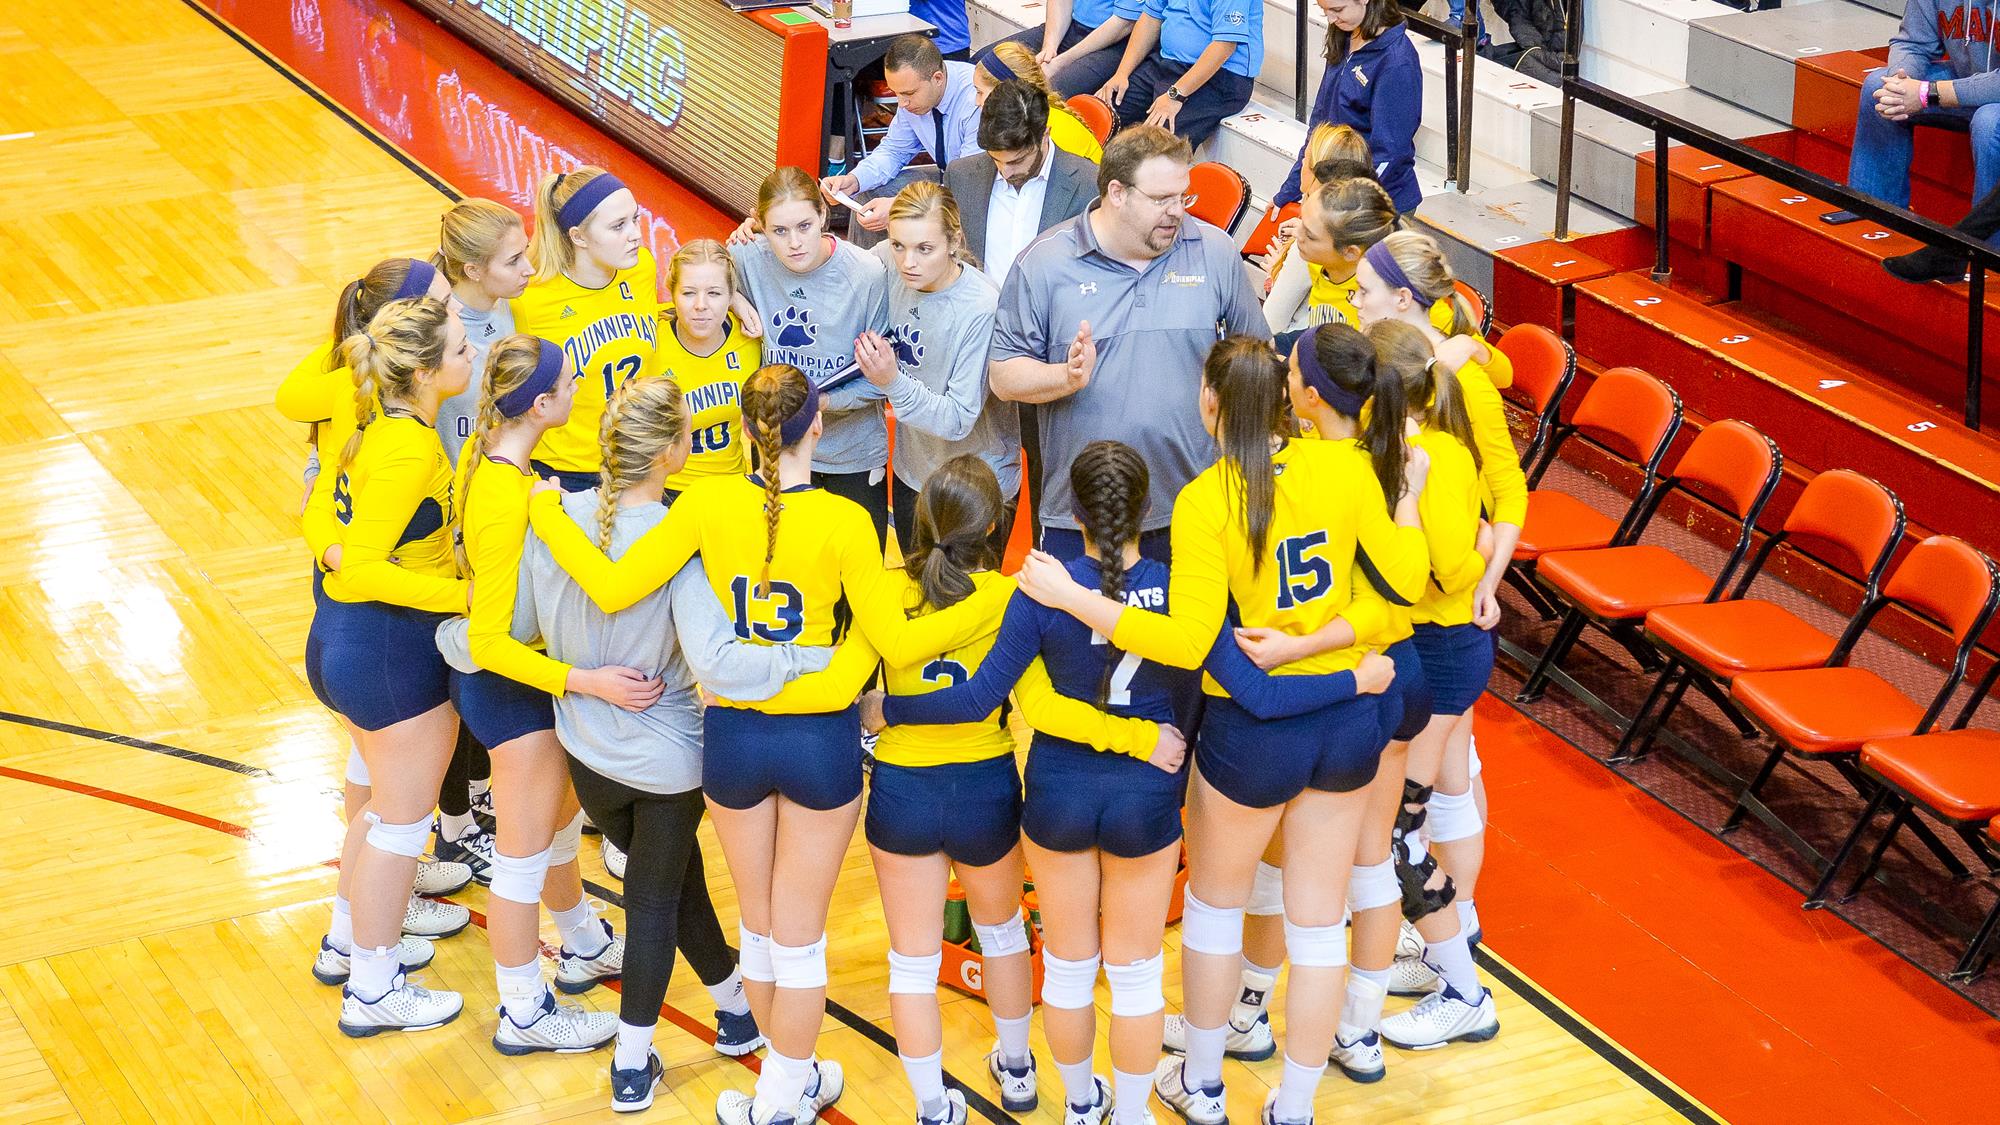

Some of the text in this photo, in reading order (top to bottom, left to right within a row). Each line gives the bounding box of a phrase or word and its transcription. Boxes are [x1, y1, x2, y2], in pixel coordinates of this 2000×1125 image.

[1240, 113, 1267, 123] 15
[1780, 195, 1808, 205] 2
[1495, 235, 1521, 244] B
[1861, 231, 1890, 240] 3
[619, 281, 634, 300] Q
[1633, 296, 1662, 306] 2
[1720, 334, 1751, 344] 3
[725, 351, 741, 370] Q
[602, 354, 642, 400] 12
[1817, 378, 1849, 390] 4
[1907, 421, 1938, 432] 5
[690, 421, 731, 454] 10
[1275, 529, 1332, 610] 15
[730, 574, 804, 642] 13
[961, 960, 981, 990] G
